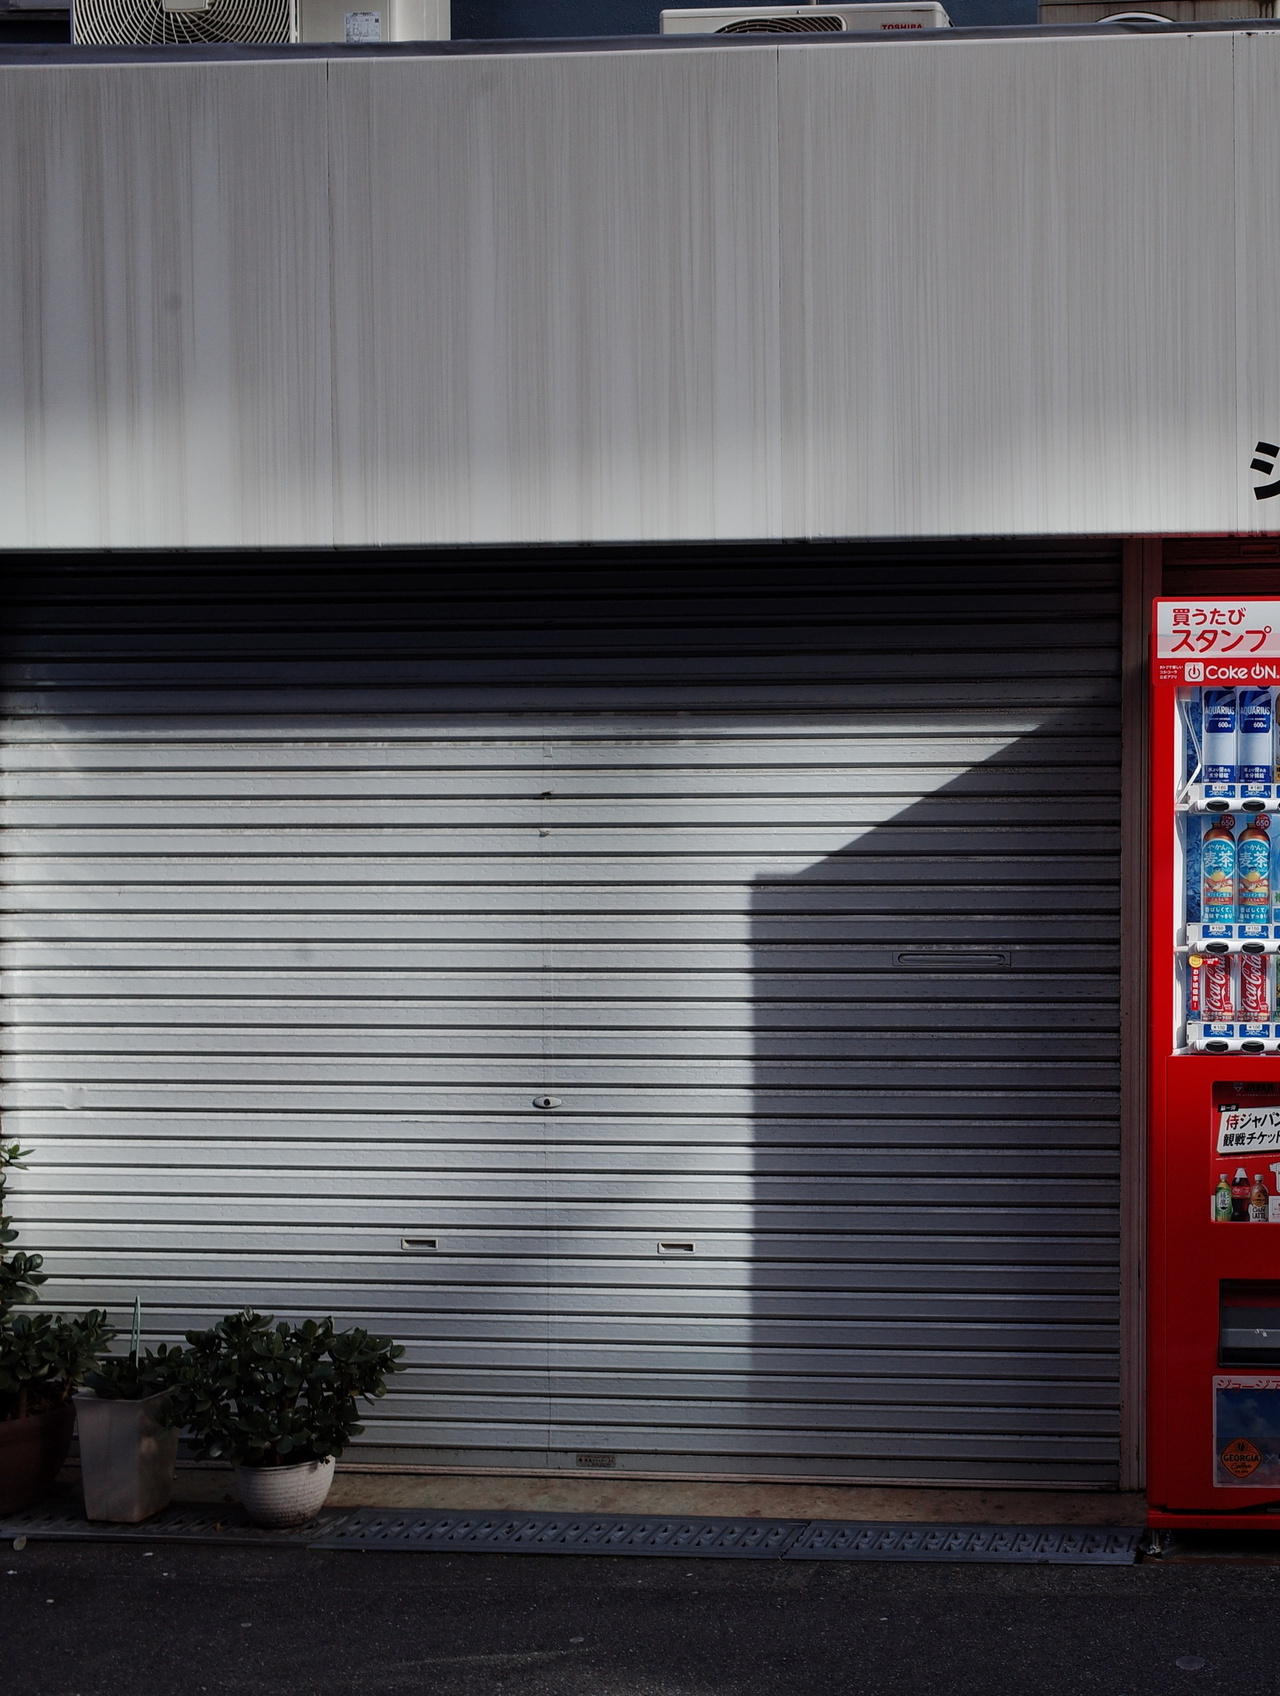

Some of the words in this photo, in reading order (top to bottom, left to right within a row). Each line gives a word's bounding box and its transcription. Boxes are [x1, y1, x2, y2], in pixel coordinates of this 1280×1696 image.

[1172, 606, 1247, 627] 買うたび
[1171, 625, 1272, 653] スタンプ
[1205, 665, 1248, 679] Coke
[1204, 706, 1235, 716] AQUARIUS
[1240, 706, 1271, 716] AQUARIUS
[1204, 851, 1234, 868] 麦茶
[1239, 851, 1269, 868] 麦茶
[1223, 1454, 1260, 1462] GEORGIA
